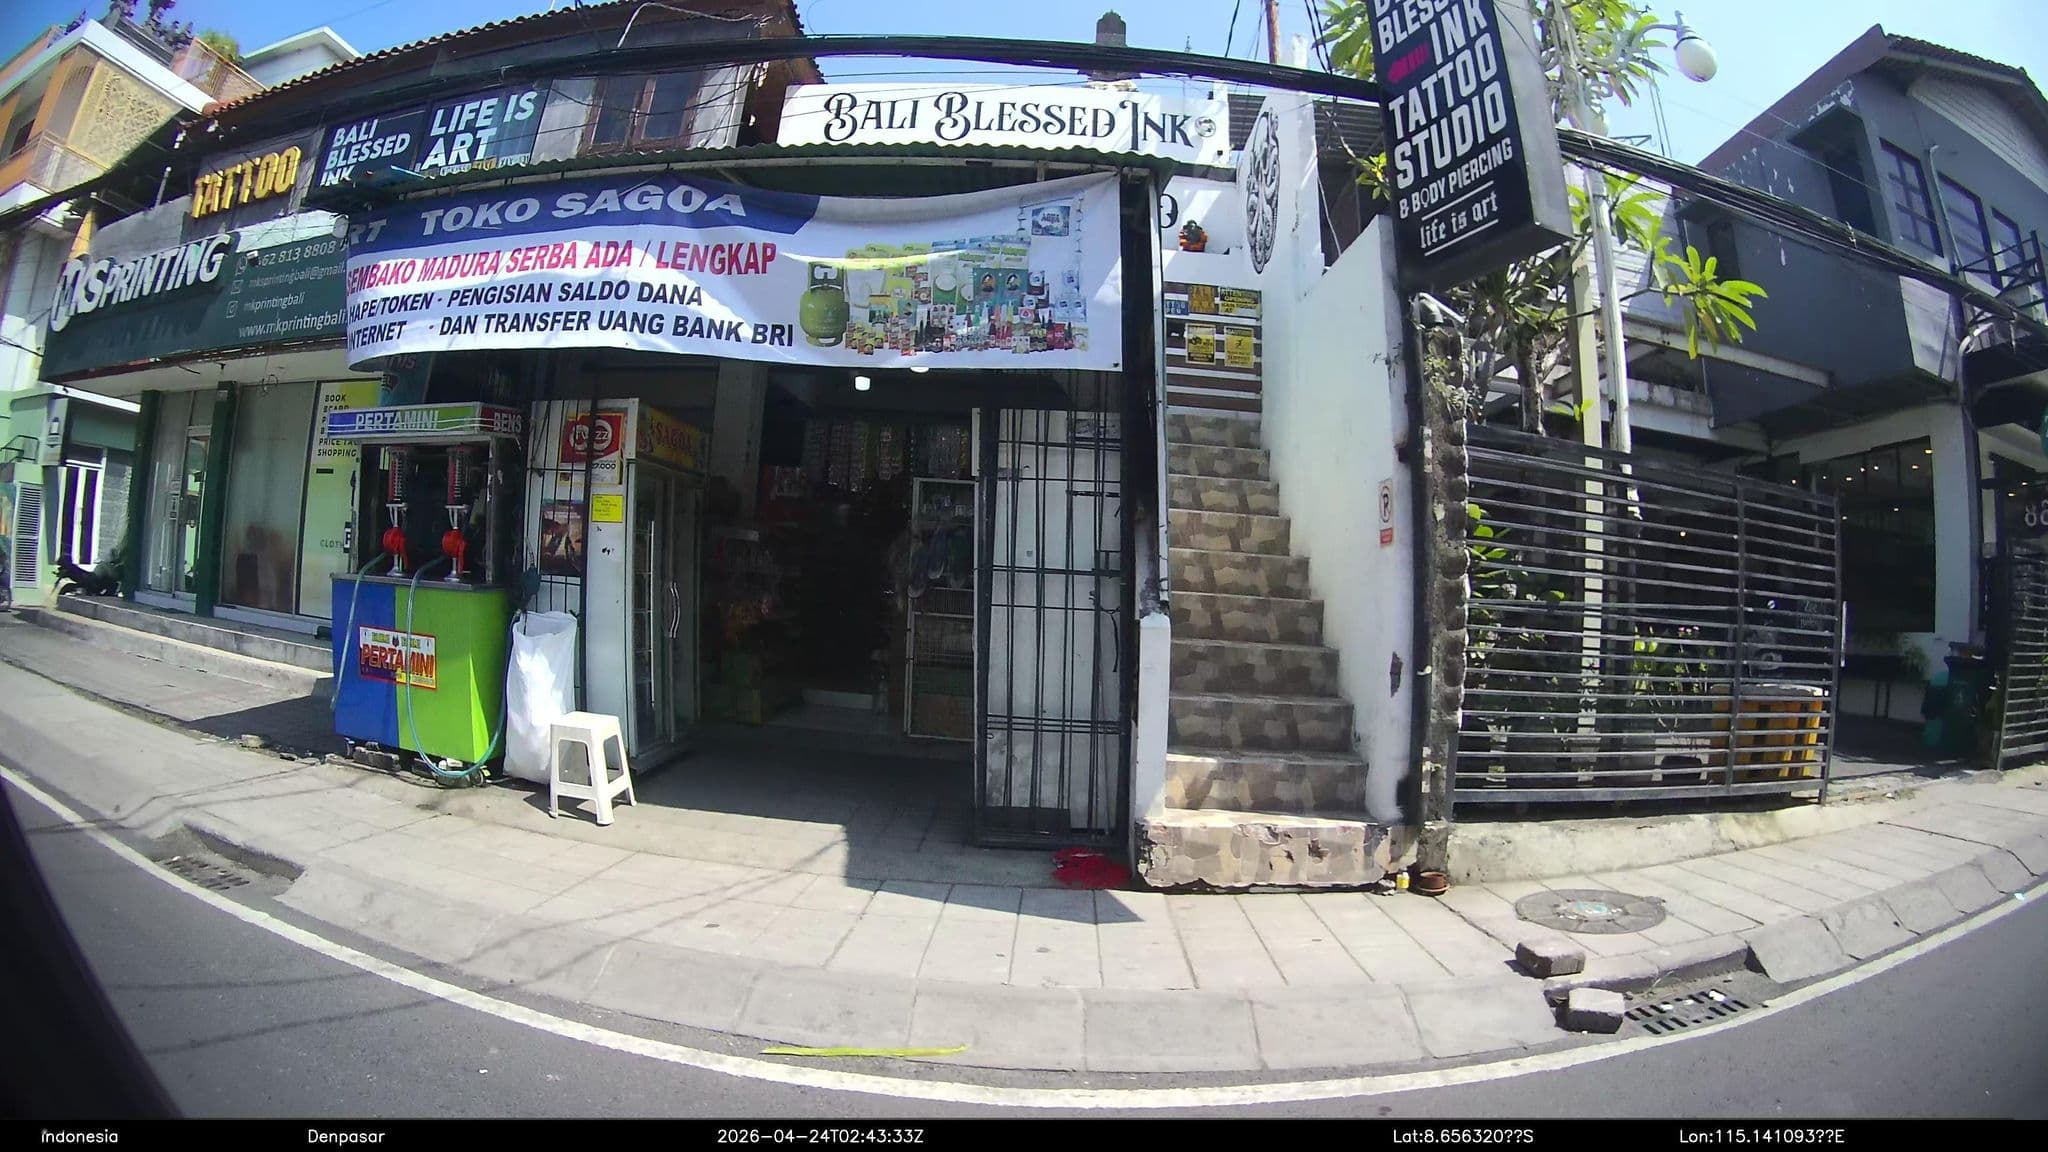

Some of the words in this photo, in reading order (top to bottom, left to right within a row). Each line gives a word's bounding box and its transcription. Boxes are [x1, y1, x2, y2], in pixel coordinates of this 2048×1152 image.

[1429, 0, 1488, 65] INK
[1388, 33, 1498, 139] TATTOO
[332, 119, 379, 148] BALI
[430, 97, 499, 137] LIFE
[503, 91, 538, 123] IS
[1393, 80, 1508, 189] STUDIO
[325, 133, 411, 170] BLESSED
[421, 127, 498, 171] ART
[190, 145, 301, 219] TATTOO
[320, 165, 356, 187] INK
[1399, 198, 1409, 219] &
[1411, 177, 1446, 213] BODY
[1448, 137, 1513, 194] PIERCING
[421, 197, 541, 236] TOKO
[551, 184, 747, 218] SAGOA
[1420, 219, 1446, 249] life
[1451, 210, 1468, 233] is
[1472, 191, 1498, 222] art
[346, 257, 417, 297] SEMBAKO
[418, 247, 502, 281] MADURA
[502, 239, 578, 272] SERBA
[583, 239, 634, 269] ADA
[656, 240, 777, 276] LENGKAP
[348, 291, 434, 324] HAPE/TOKEN
[447, 282, 551, 308] PENGISIAN
[557, 279, 630, 302] SALDO
[636, 282, 702, 306] DANA
[439, 314, 480, 336] DAN
[483, 310, 591, 334] TRANSFER
[598, 310, 665, 336] UANG
[672, 313, 742, 342] BANK
[751, 323, 794, 347] BRI
[324, 394, 346, 402] BOOK
[355, 410, 440, 431] PERTAMINI
[317, 448, 357, 457] SHOPPING
